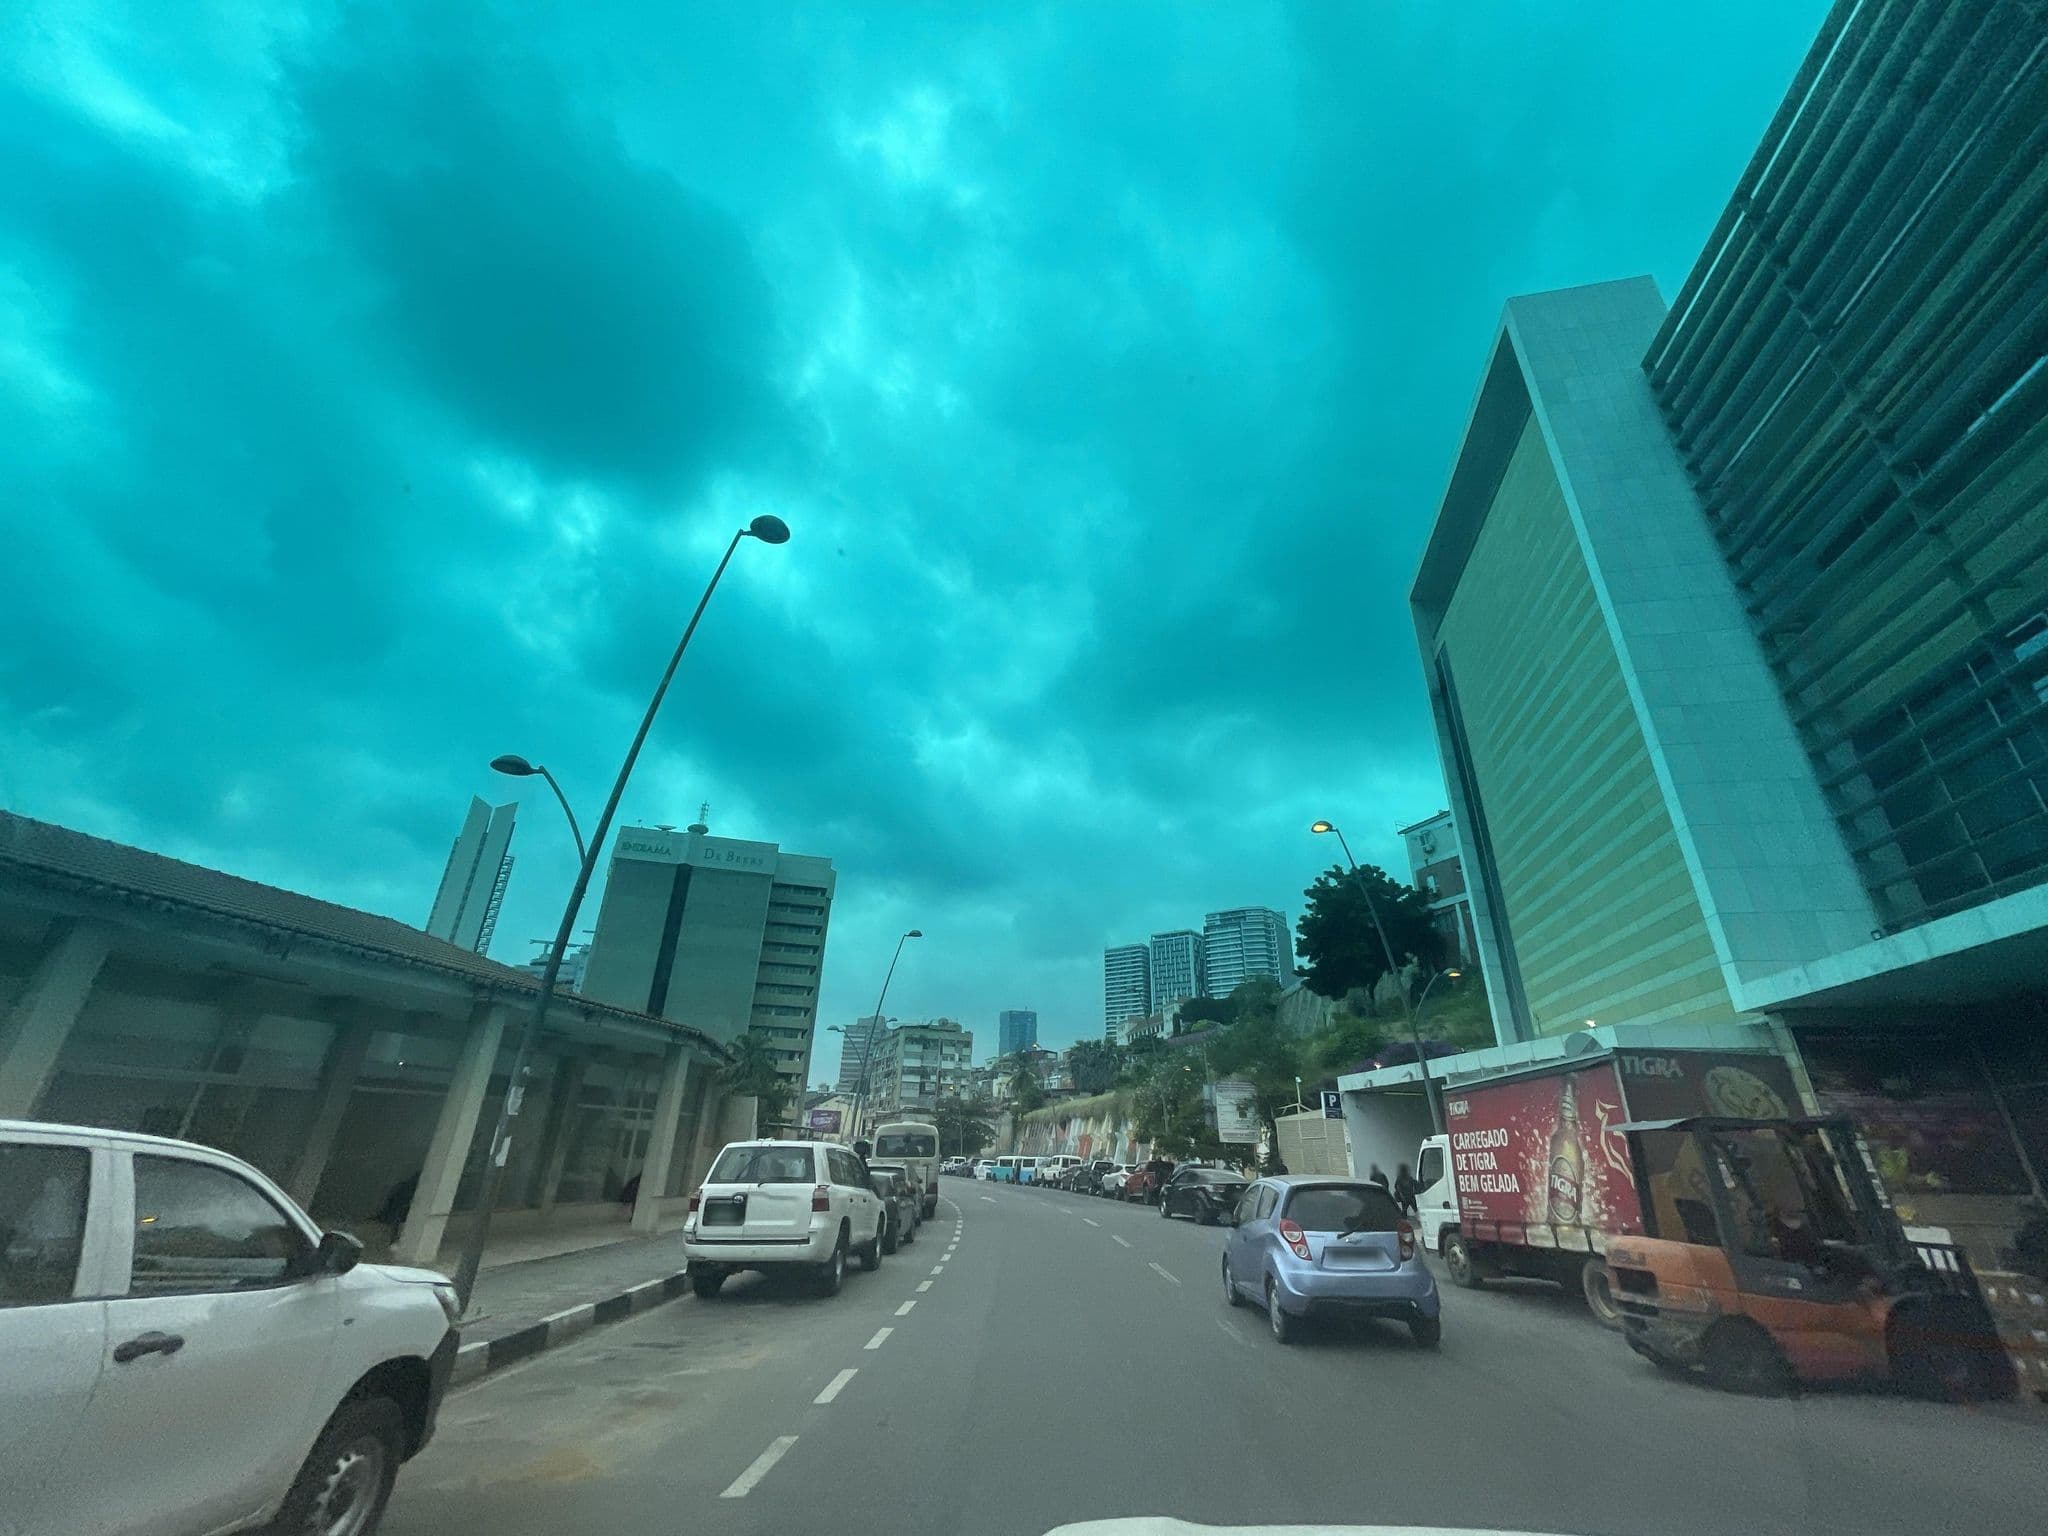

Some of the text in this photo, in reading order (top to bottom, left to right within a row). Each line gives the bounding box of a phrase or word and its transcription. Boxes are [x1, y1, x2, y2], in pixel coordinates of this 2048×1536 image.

[1622, 1056, 1683, 1077] TIGRA
[1329, 1094, 1337, 1107] P
[1449, 1101, 1469, 1115] TIGRA
[1453, 1128, 1508, 1150] CARREGADO
[1456, 1152, 1497, 1171] DE TIGRA
[1459, 1173, 1519, 1193] BEM GELADA
[1550, 1174, 1577, 1202] TIGRA
